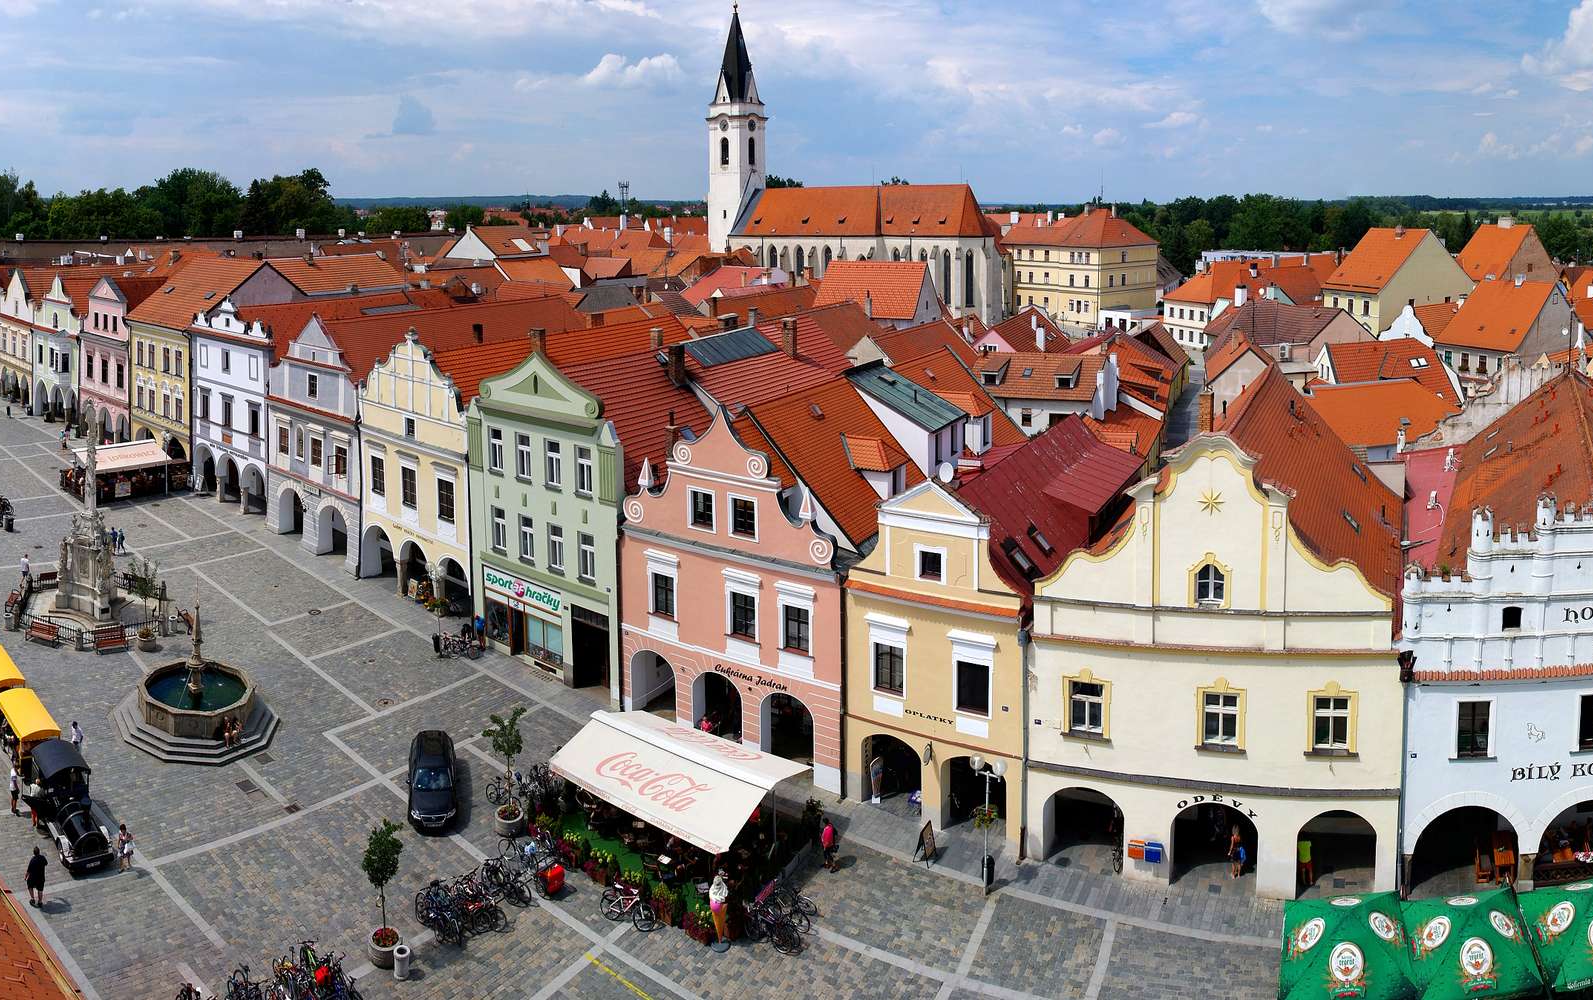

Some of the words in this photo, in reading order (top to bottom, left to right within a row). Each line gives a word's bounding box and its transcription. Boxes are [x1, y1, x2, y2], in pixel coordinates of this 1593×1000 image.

[485, 572, 513, 590] sport
[525, 586, 561, 611] hračky
[714, 663, 753, 682] Cukrárna
[755, 675, 788, 692] Jadran
[904, 709, 955, 725] OPLATKY
[595, 751, 712, 813] Coca-Cola
[1510, 761, 1562, 782] BÍLÝ
[1176, 793, 1258, 819] ODĚVY
